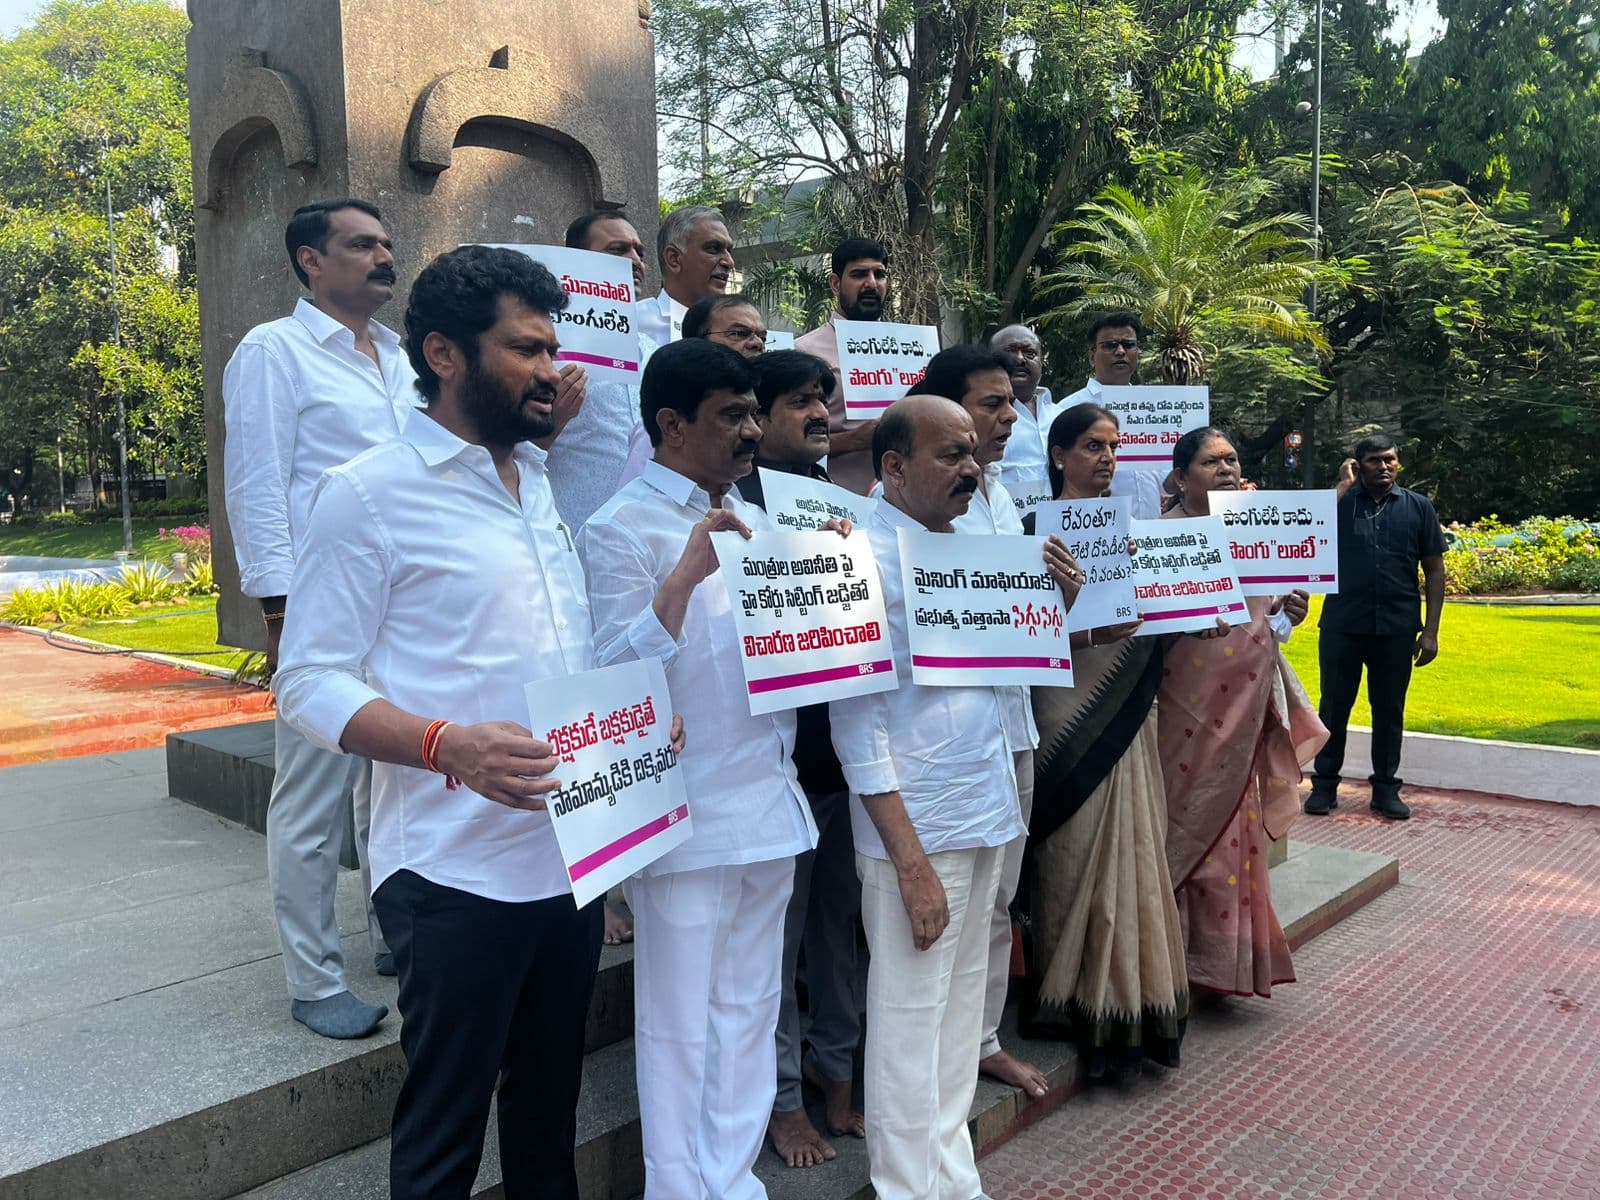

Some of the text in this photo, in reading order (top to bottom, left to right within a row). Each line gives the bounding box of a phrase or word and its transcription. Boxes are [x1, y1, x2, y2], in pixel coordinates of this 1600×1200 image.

[612, 359, 625, 369] BRS
[742, 554, 856, 579] మంత్రుల అవినీతి పై
[913, 567, 968, 595] మైనింగ్
[970, 570, 1055, 592] మాఫియాకు
[739, 590, 757, 616] హై
[758, 585, 784, 617] కోర్టు
[786, 585, 824, 616] సిట్టింగ్
[1116, 606, 1132, 618] BRS
[915, 607, 960, 630] ప్రభుత్వ
[961, 609, 1011, 631] వత్తాసా
[743, 621, 881, 657] విచారణ జరిపించాలి
[858, 663, 874, 675] BRS
[1050, 658, 1061, 668] BRS
[551, 758, 633, 818] సామాన్యుడికి
[668, 810, 679, 824] BRS
